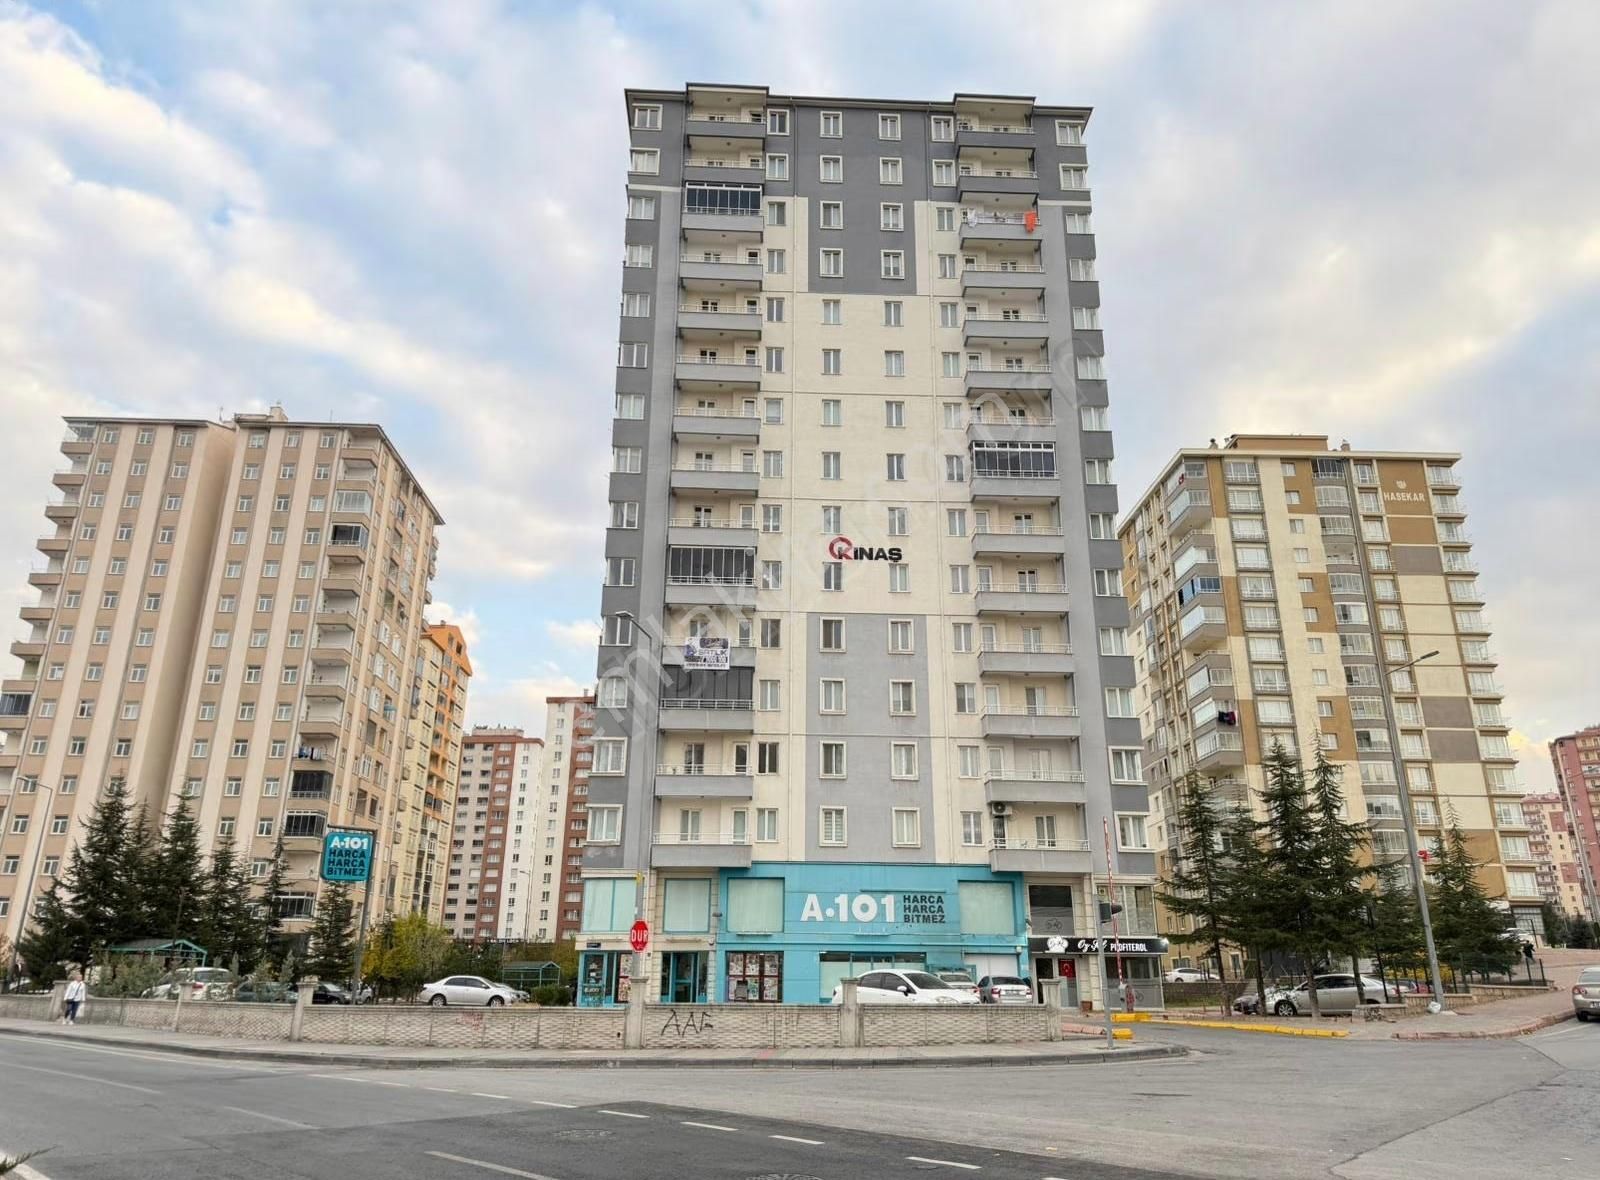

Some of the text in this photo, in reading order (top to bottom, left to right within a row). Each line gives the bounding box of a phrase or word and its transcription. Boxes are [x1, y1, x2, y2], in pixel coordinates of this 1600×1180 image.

[1383, 492, 1425, 502] HASEKAR
[329, 849, 366, 858] HARCA
[328, 858, 365, 868] HARCA
[903, 895, 944, 904] HARCA
[903, 905, 945, 914] HARCA
[632, 929, 648, 943] DUR
